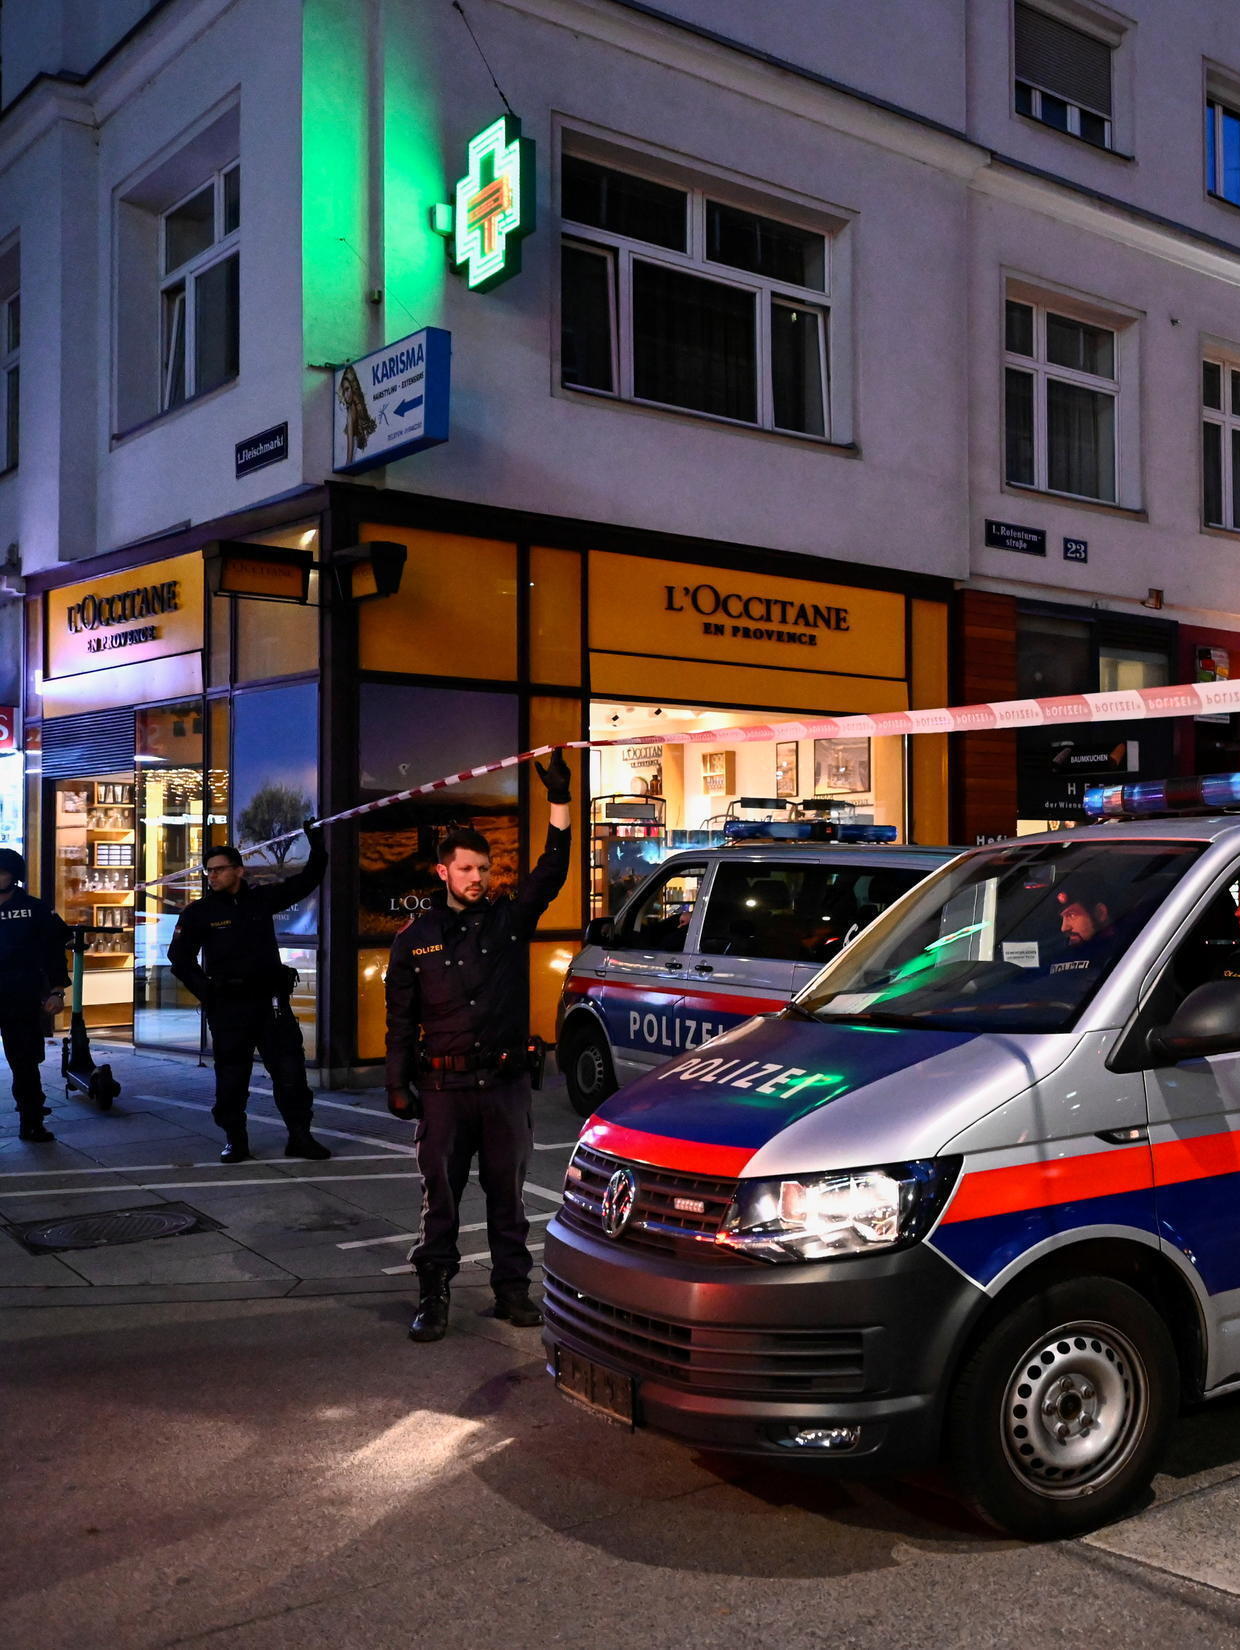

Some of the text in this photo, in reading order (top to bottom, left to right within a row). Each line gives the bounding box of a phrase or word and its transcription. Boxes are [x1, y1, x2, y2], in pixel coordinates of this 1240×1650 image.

[372, 344, 424, 386] KARISMA
[1067, 541, 1085, 559] 23
[67, 581, 179, 634] L'OCCITANE
[664, 583, 849, 631] L'OCCITANE
[102, 625, 157, 650] PROVENCE
[703, 622, 817, 646] EN PROVENCE
[1070, 754, 1108, 764] BAUMKUCHEN
[1044, 801, 1058, 809] der
[657, 1058, 825, 1100] POLIZEI
